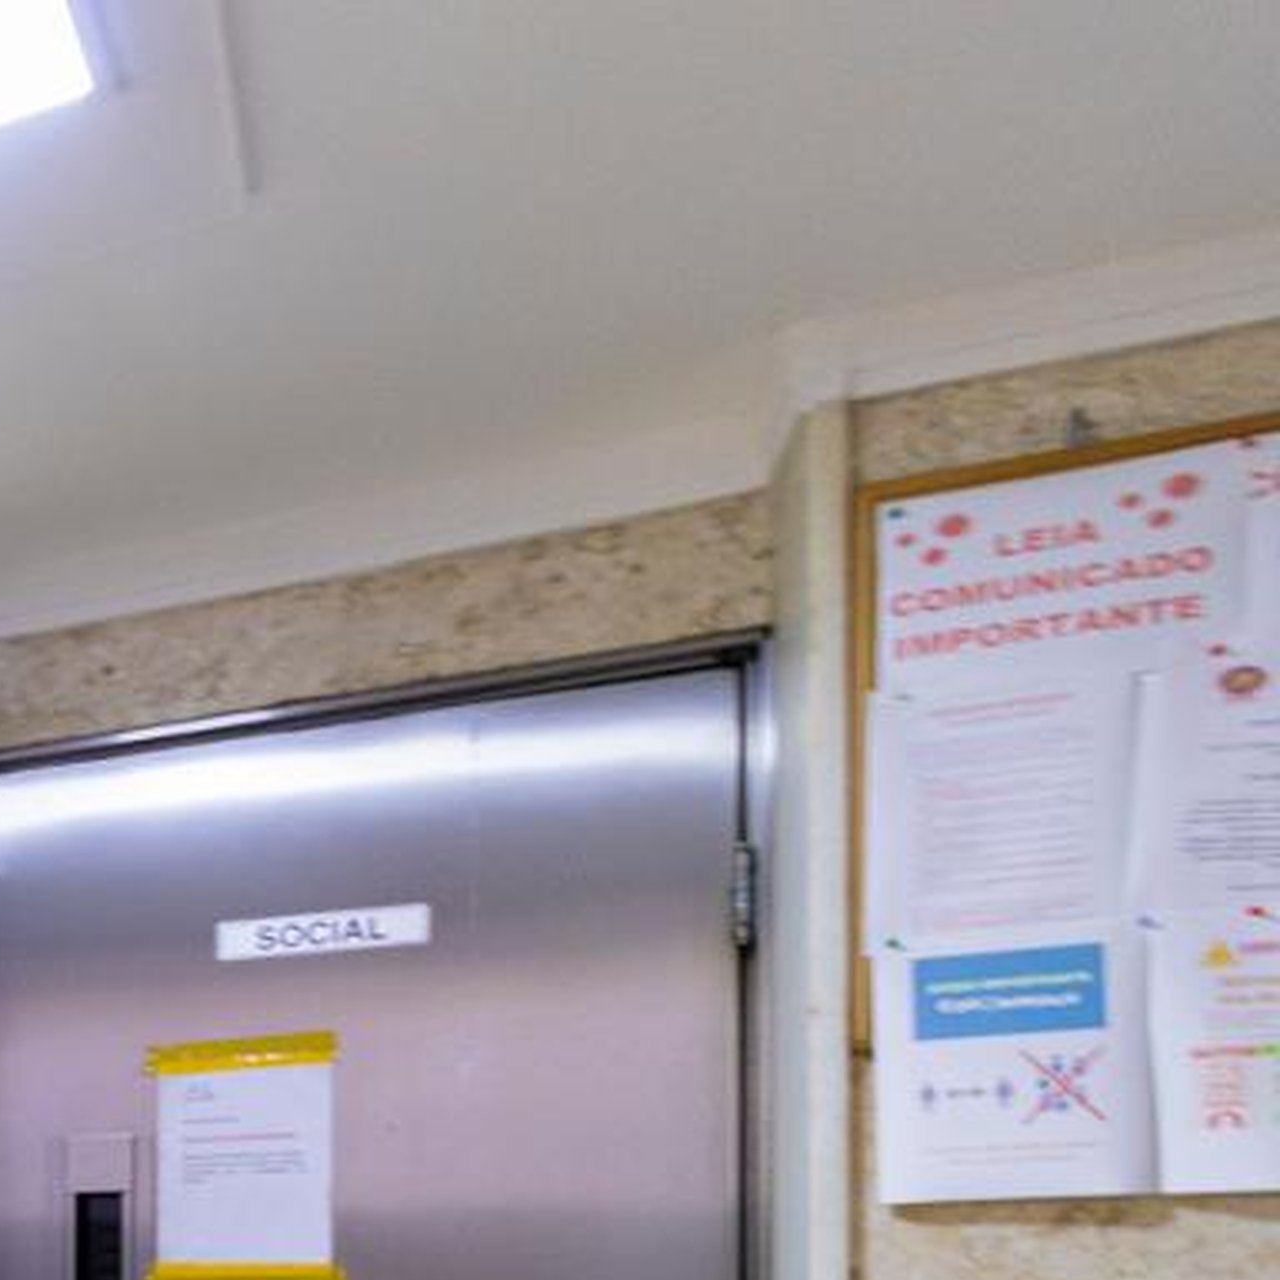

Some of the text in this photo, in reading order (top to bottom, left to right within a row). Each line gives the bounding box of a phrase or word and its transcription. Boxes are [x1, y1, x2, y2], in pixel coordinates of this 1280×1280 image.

[994, 519, 1100, 556] LEIA
[893, 546, 1213, 616] COMUNICADO
[895, 594, 1203, 658] IMPORTANTE
[256, 916, 386, 951] SOCIAL
